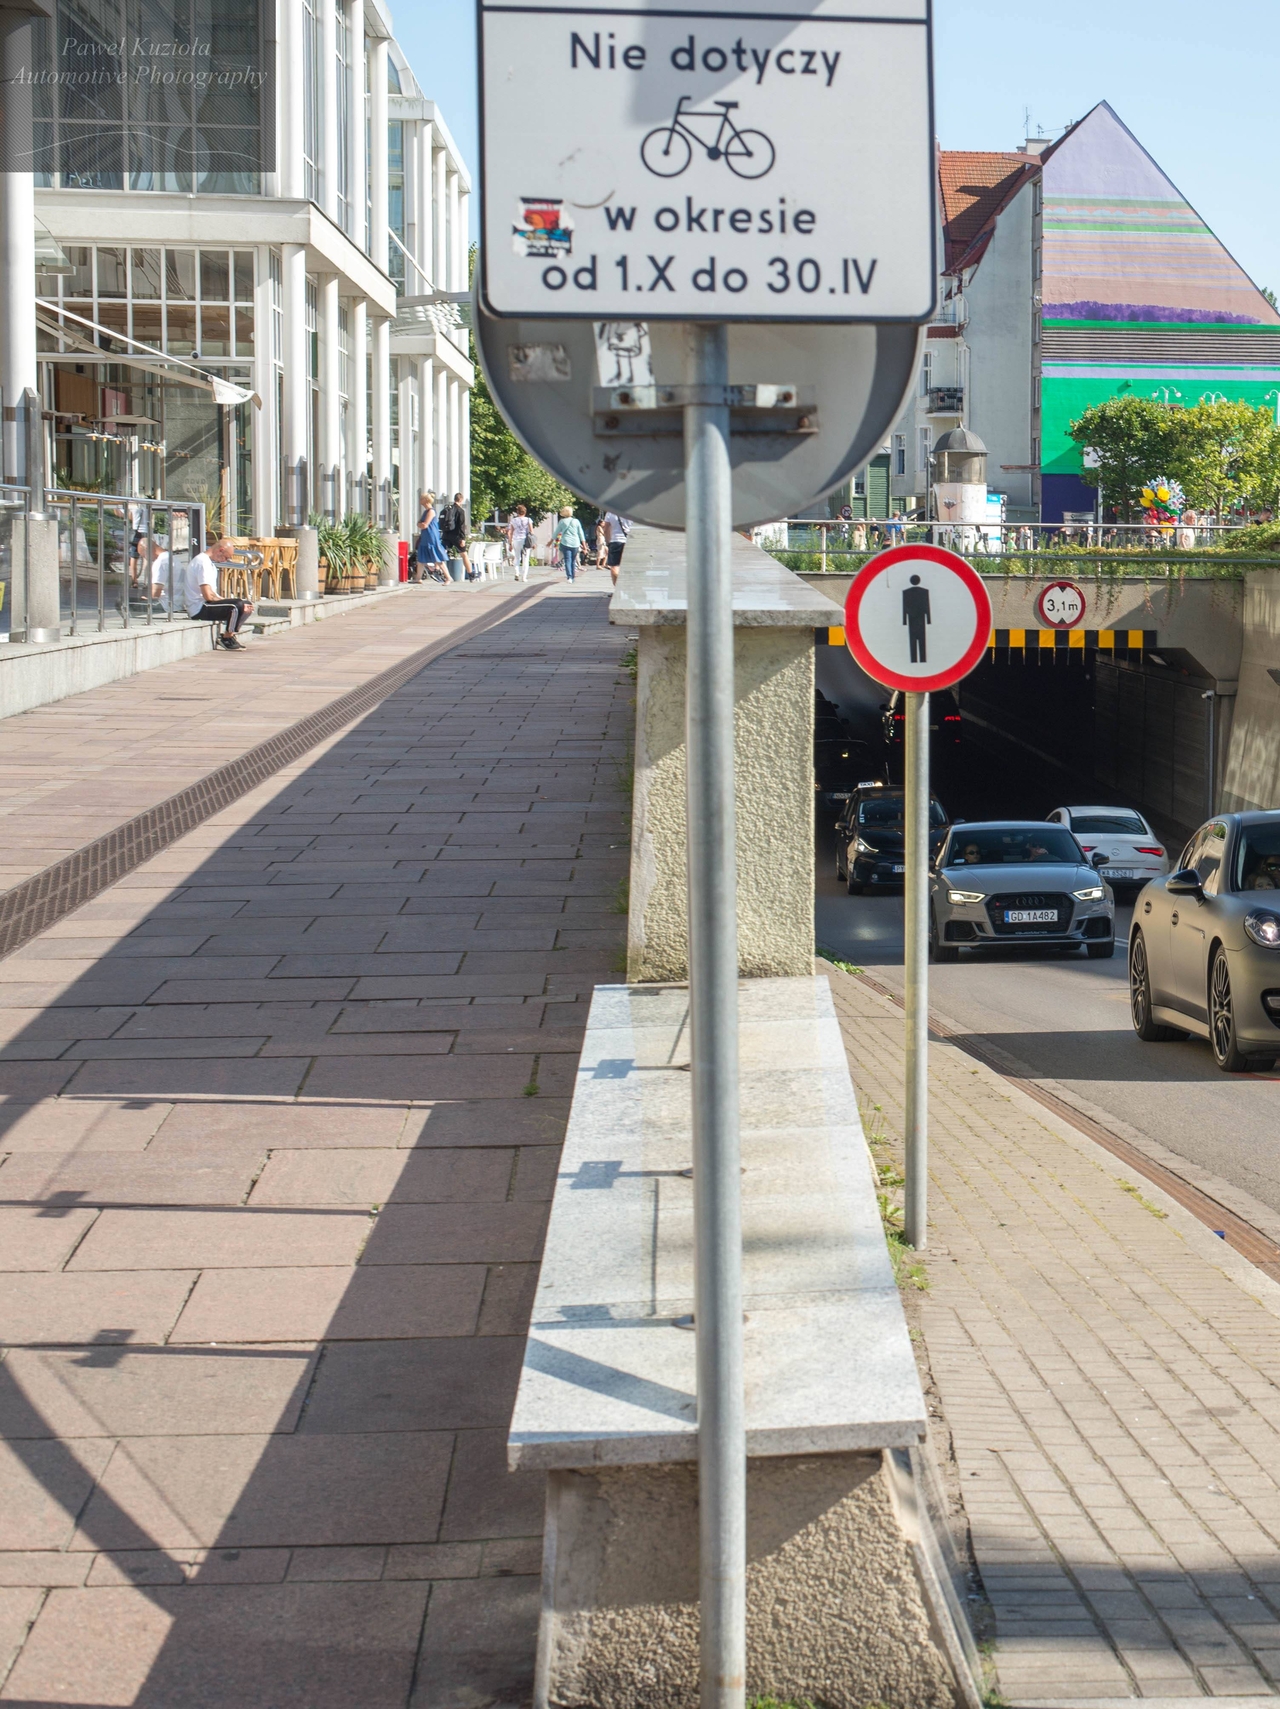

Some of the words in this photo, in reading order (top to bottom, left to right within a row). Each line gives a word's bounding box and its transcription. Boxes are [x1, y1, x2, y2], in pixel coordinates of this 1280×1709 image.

[571, 32, 646, 71] Nie
[670, 35, 840, 87] dotyczy
[604, 206, 637, 231] w
[654, 196, 816, 234] okresie
[542, 256, 597, 291] od
[615, 255, 675, 292] 1.X
[692, 256, 748, 293] do
[767, 257, 877, 294] 30.IV
[1011, 911, 1024, 921] GD
[1027, 911, 1055, 921] 1A482
